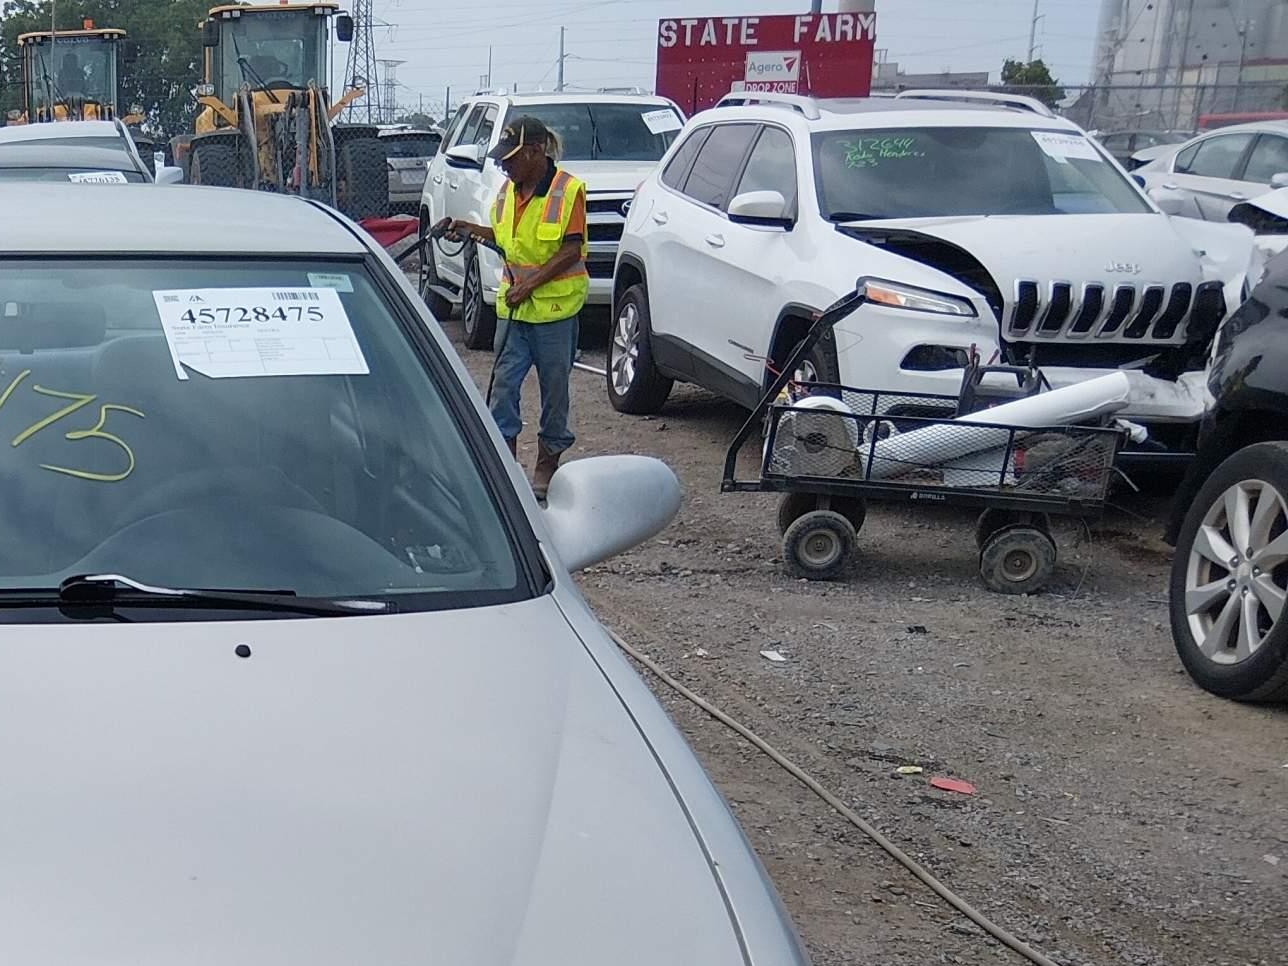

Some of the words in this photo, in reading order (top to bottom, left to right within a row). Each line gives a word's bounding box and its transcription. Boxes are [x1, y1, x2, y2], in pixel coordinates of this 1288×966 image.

[659, 18, 760, 47] STATE
[793, 13, 875, 43] FARM
[748, 61, 783, 75] Agero
[746, 82, 772, 93] DROP
[773, 81, 796, 93] ZONE
[1104, 260, 1142, 275] Jeep
[181, 306, 324, 324] 45728475
